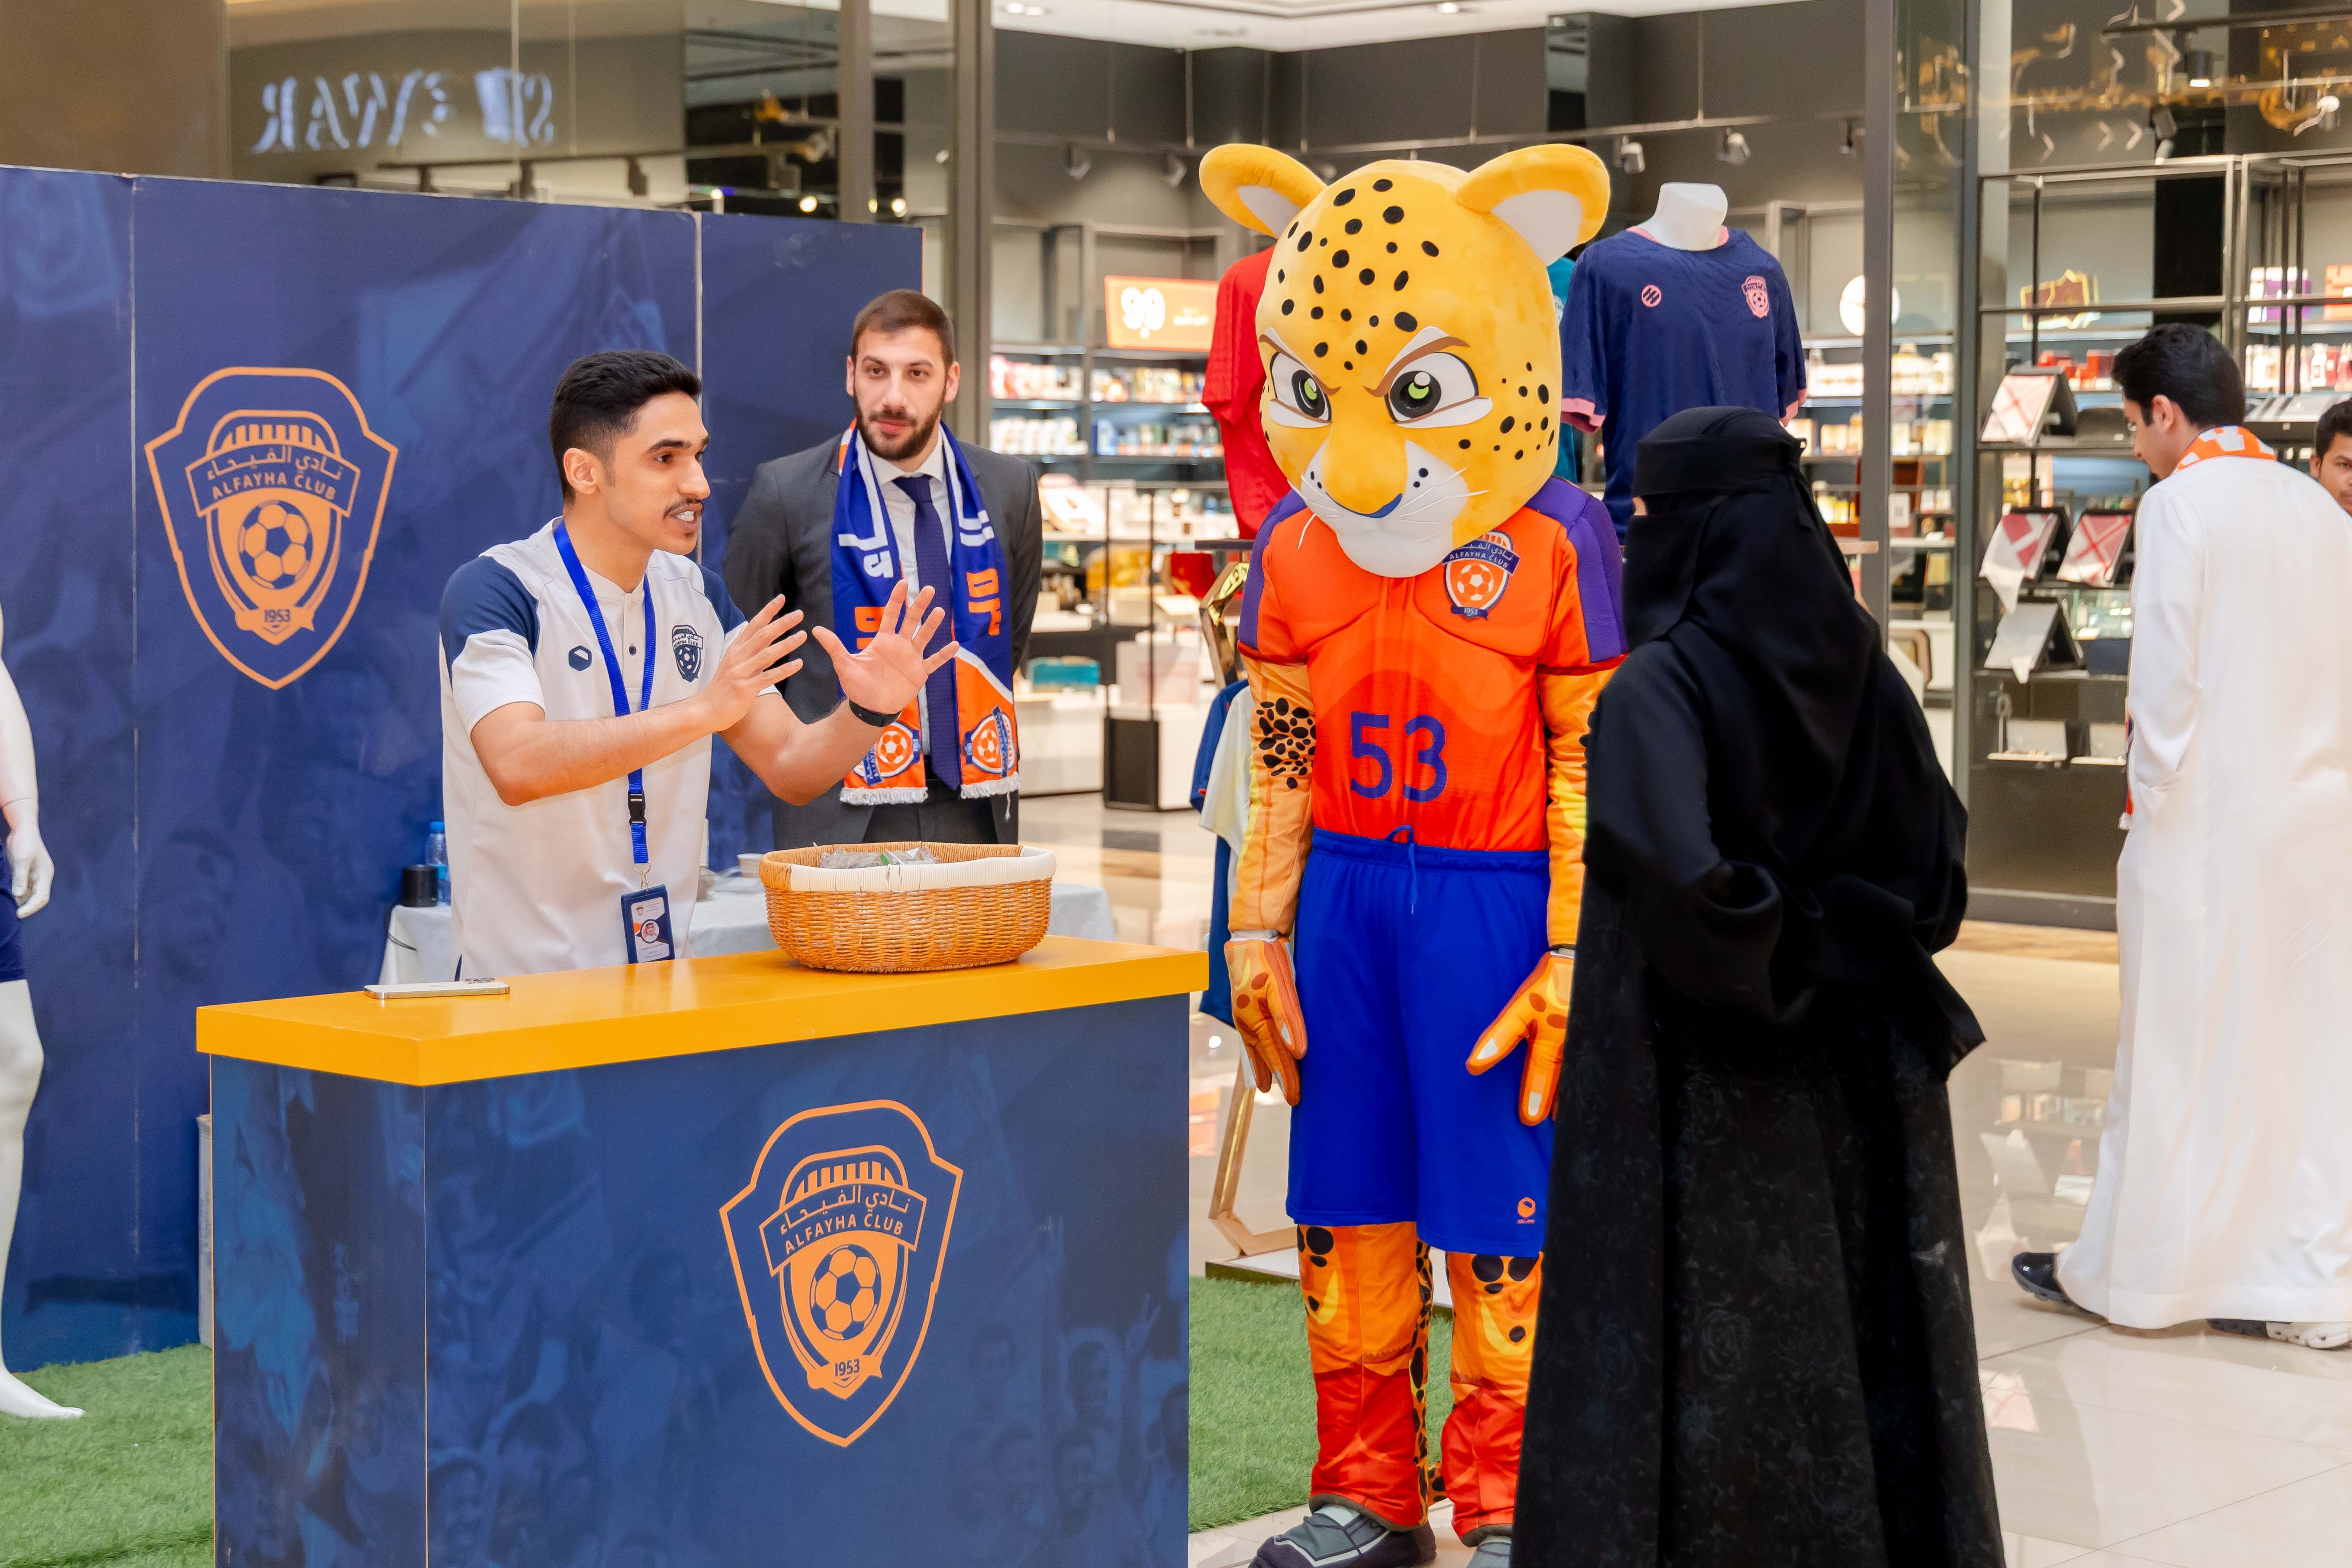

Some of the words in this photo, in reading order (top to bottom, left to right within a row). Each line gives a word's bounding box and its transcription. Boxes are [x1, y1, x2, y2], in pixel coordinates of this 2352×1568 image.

[207, 445, 292, 480] الفيحاء
[295, 455, 344, 480] نادي
[212, 472, 287, 499] ALFAYHA
[294, 474, 336, 500] CLUB
[1450, 551, 1486, 560] ALFAYHA
[1489, 554, 1509, 568] CLUB
[265, 609, 290, 622] 1953
[1350, 712, 1448, 803] 53
[780, 1184, 861, 1235] الفيحاء
[865, 1189, 911, 1213] نادي
[785, 1213, 857, 1255] ALFAYHA
[864, 1213, 904, 1235] CLUB
[835, 1359, 860, 1377] 1953
